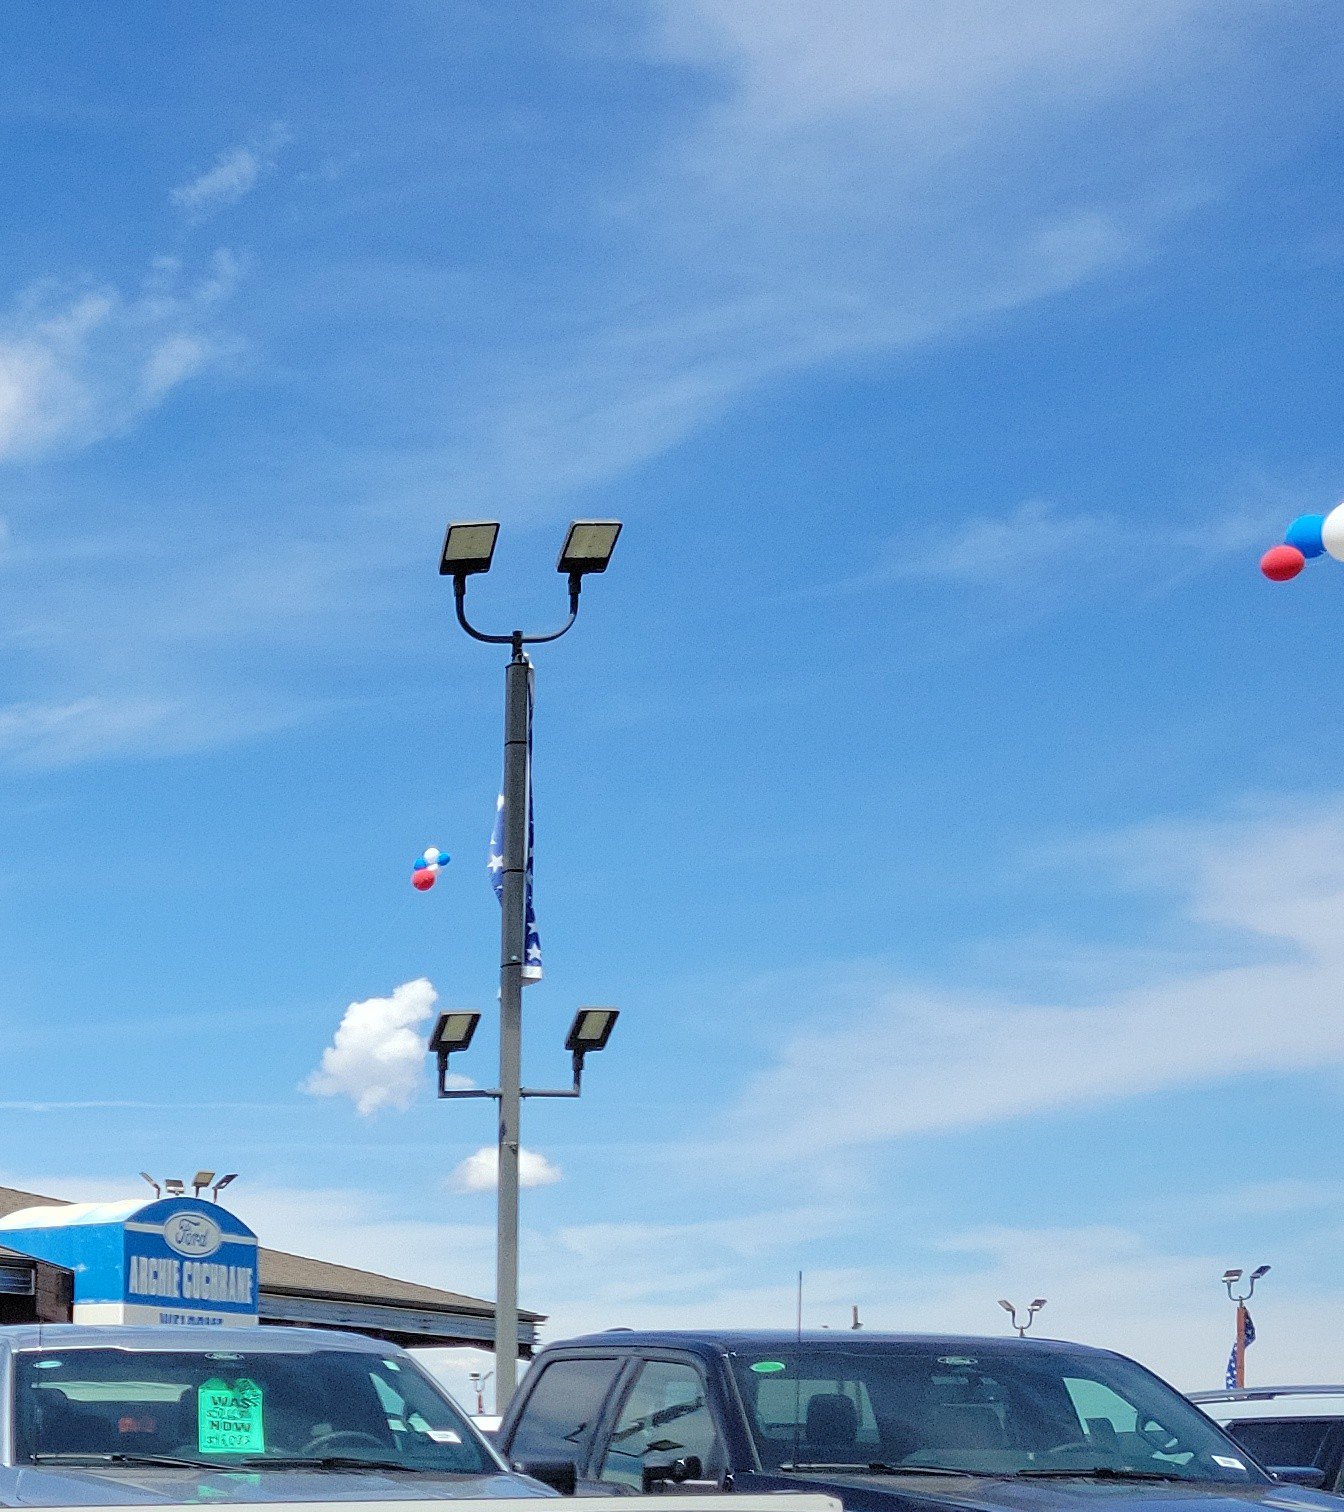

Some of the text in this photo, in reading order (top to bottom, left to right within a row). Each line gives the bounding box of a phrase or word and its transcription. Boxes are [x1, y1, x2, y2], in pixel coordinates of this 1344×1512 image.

[175, 1218, 210, 1247] Ford
[129, 1256, 253, 1304] ARCHIE COCHRANE
[211, 1396, 252, 1409] WAS
[210, 1420, 252, 1432] NOW
